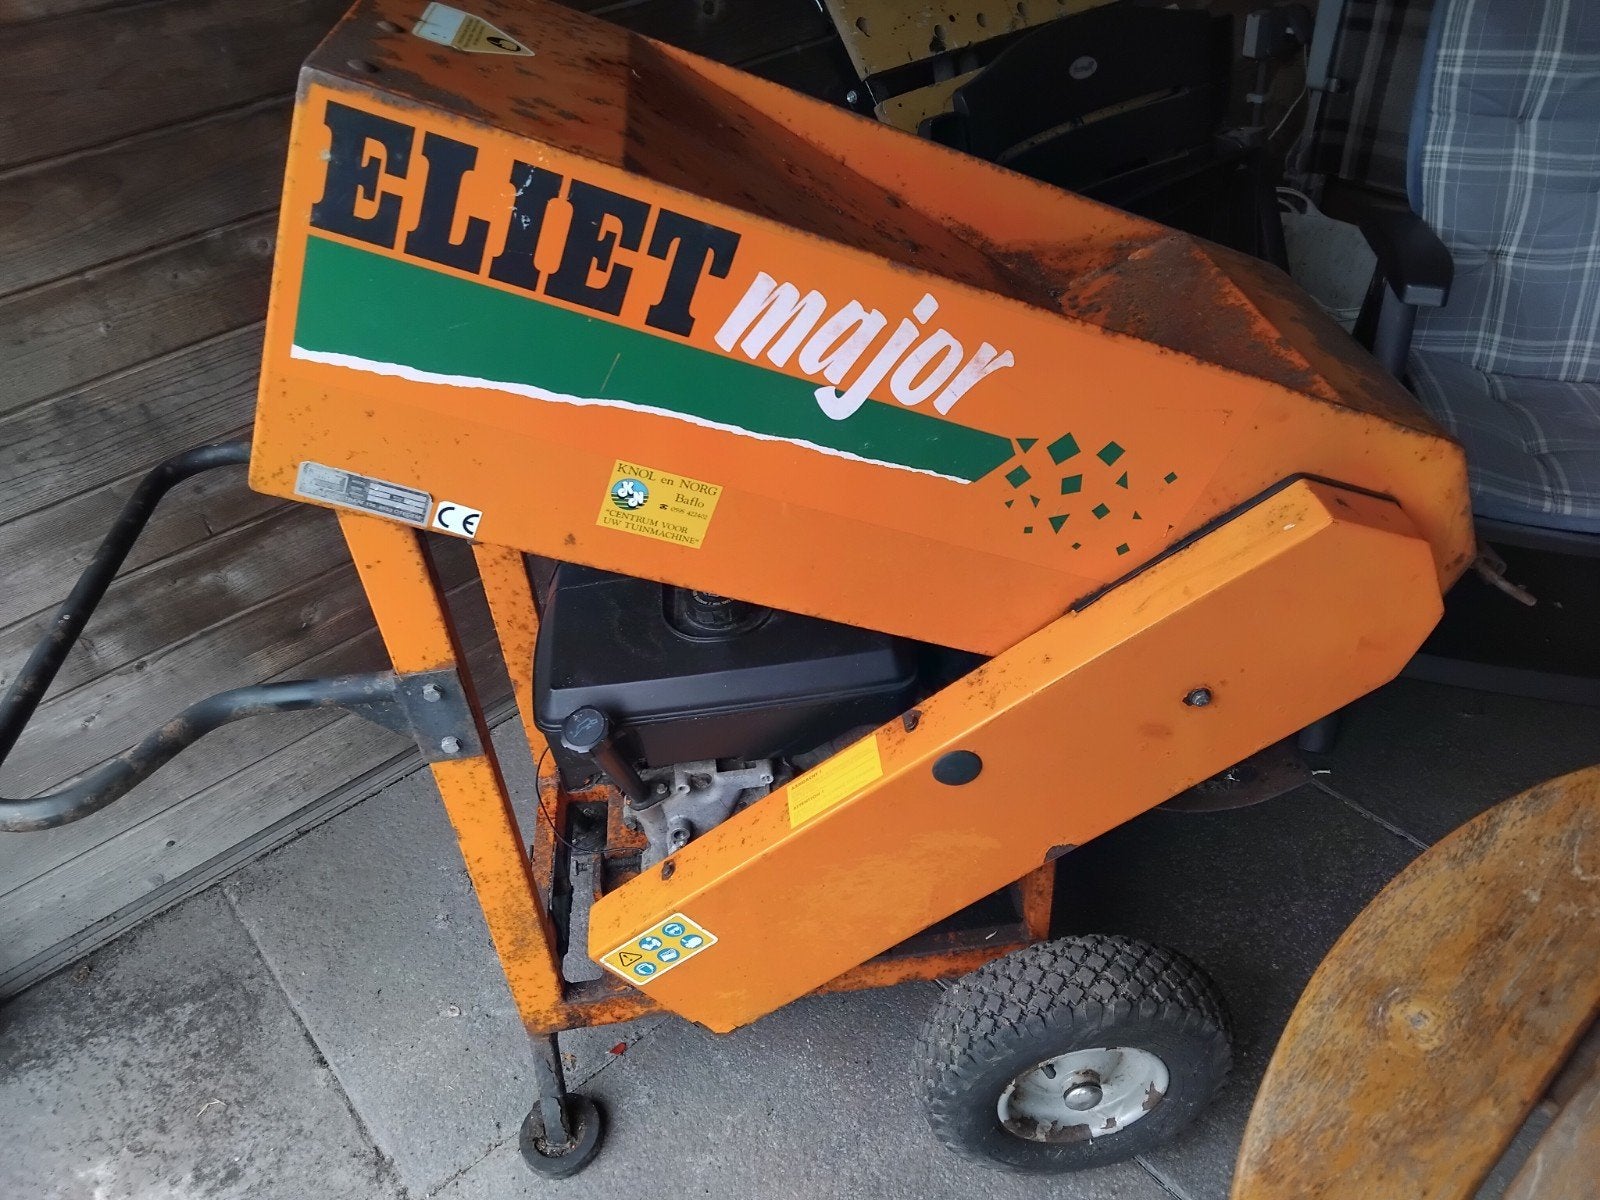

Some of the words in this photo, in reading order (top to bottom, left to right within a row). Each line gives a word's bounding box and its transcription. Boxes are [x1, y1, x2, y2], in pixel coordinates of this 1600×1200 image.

[308, 100, 741, 338] ELIET
[714, 271, 1015, 421] major
[617, 463, 656, 481] KNOL
[660, 477, 674, 486] en
[679, 479, 718, 497] NORG
[675, 493, 705, 508] Baflo
[437, 506, 480, 535] CE
[603, 516, 622, 526] UW
[661, 521, 688, 534] VOOR
